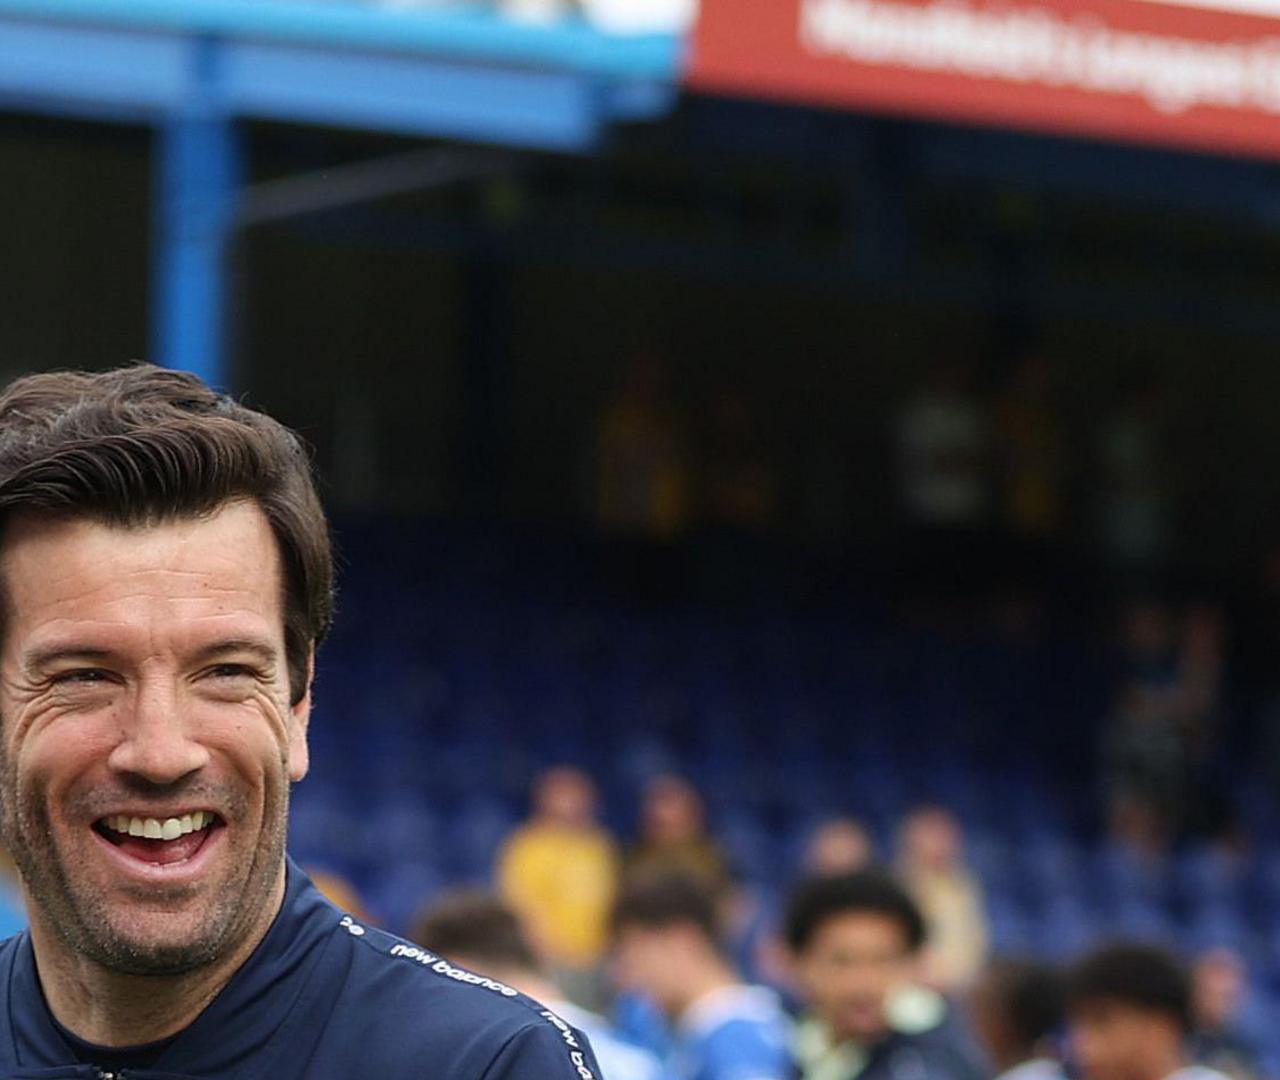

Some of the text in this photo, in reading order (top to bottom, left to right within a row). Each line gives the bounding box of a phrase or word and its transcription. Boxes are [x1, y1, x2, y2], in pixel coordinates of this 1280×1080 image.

[390, 943, 519, 997] new balance
[540, 1011, 578, 1048] new
